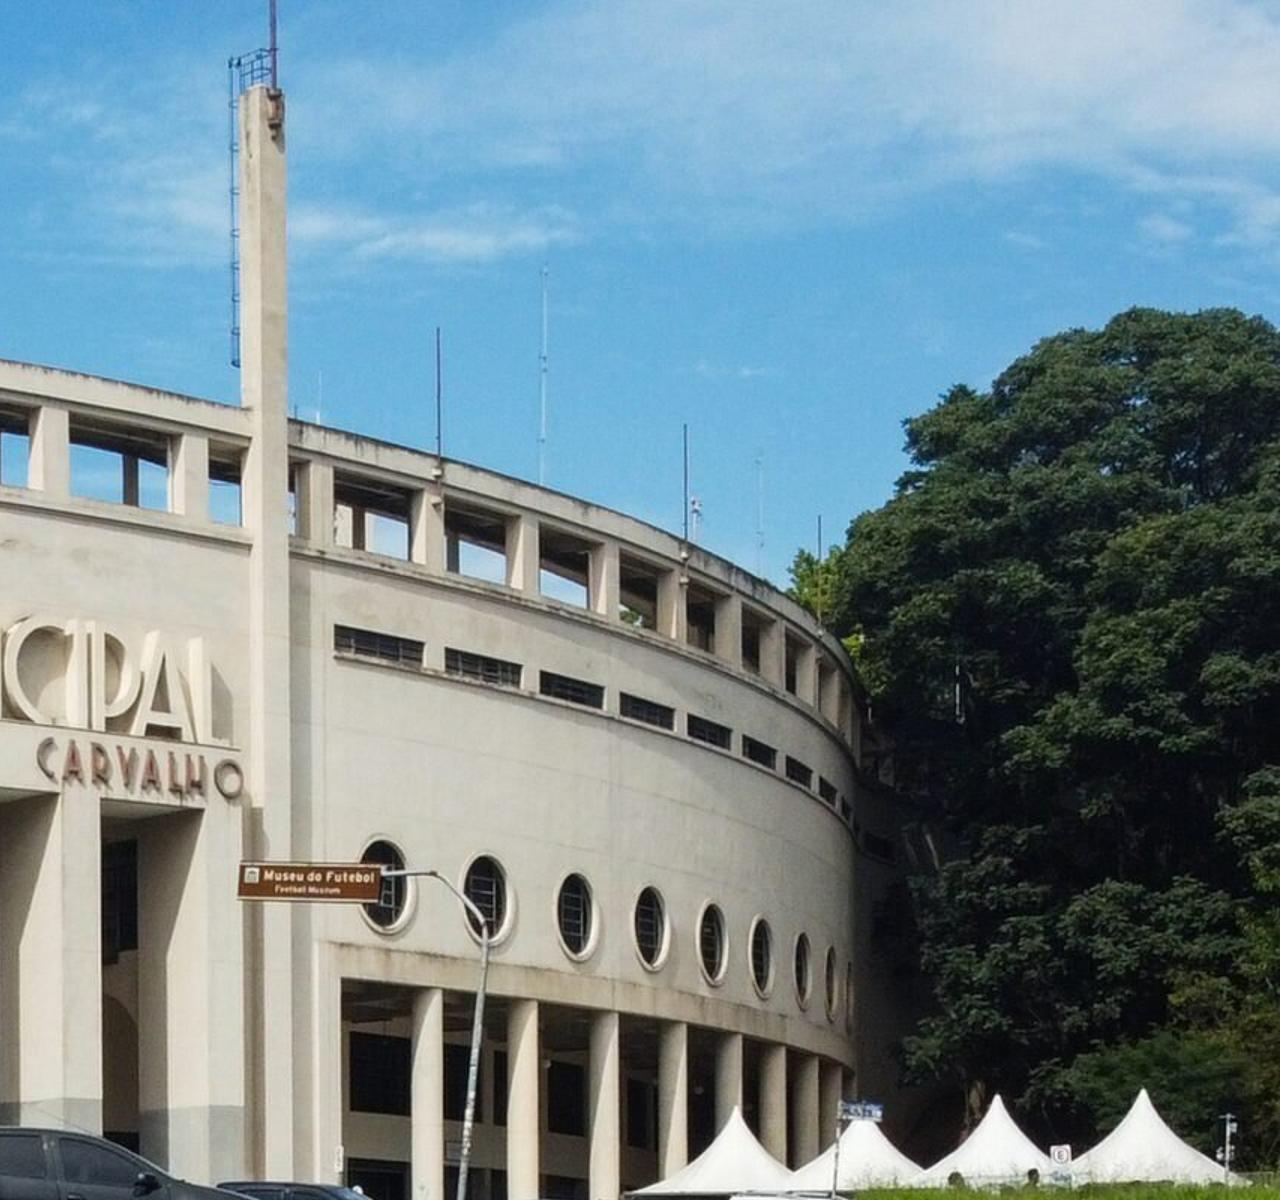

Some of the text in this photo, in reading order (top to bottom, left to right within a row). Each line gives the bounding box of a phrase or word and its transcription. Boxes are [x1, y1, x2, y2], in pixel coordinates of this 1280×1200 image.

[37, 736, 244, 800] CARVALHO
[263, 869, 375, 884] Museu do Futebol
